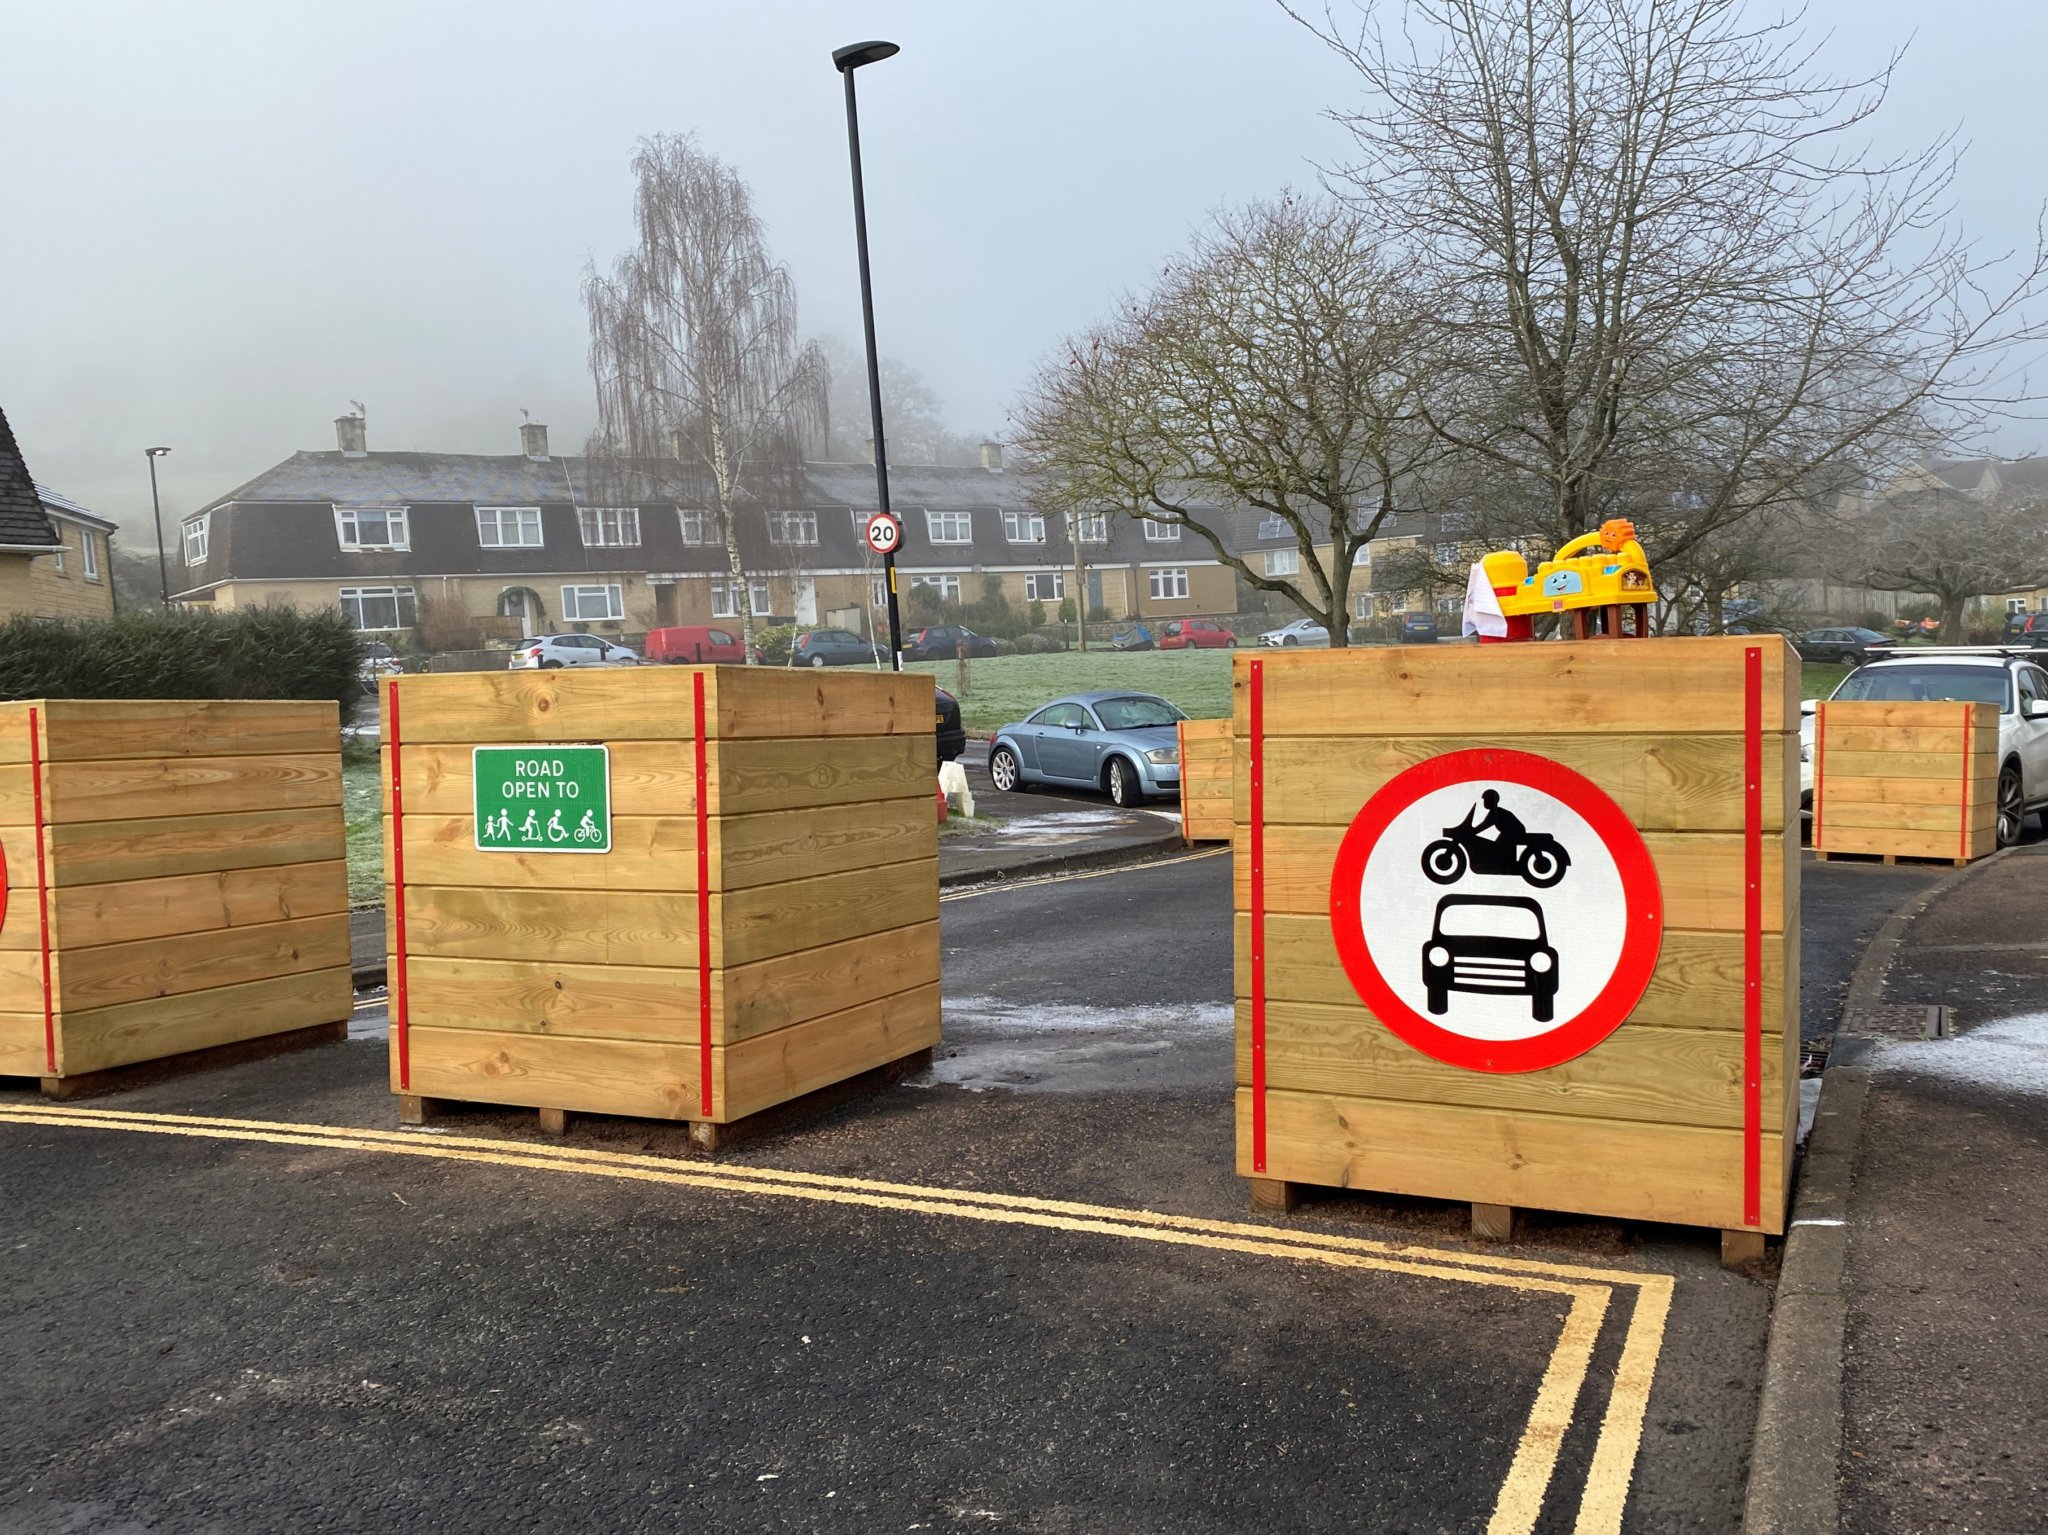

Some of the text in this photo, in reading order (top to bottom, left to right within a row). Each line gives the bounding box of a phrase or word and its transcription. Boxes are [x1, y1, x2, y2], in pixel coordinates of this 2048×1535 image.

[872, 526, 893, 541] 20
[515, 760, 564, 776] ROAD
[502, 781, 579, 798] OPEN TO
